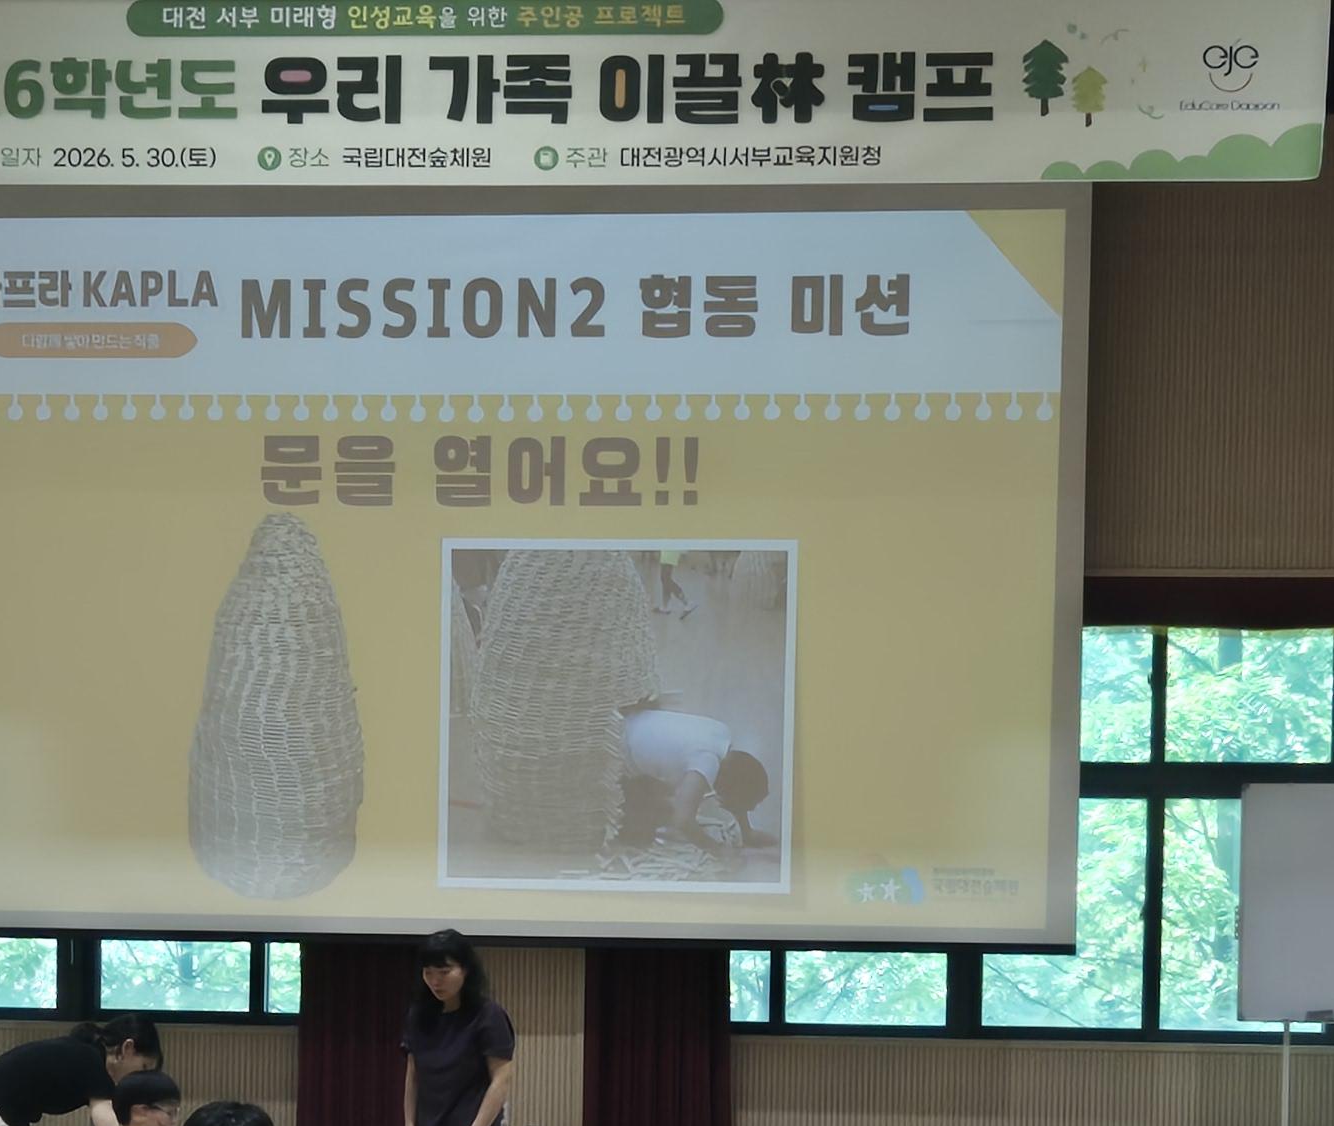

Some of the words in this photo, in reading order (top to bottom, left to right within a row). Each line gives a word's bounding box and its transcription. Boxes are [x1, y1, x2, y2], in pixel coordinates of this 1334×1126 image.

[161, 6, 207, 30] 대전
[216, 6, 260, 29] 서부
[269, 5, 337, 30] 미래형
[347, 4, 458, 29] 인성교육을
[467, 5, 508, 28] 위한
[516, 5, 584, 28] 주인공
[594, 4, 686, 27] 프로젝트
[261, 55, 403, 125] 우리
[428, 52, 573, 125] 가족
[598, 52, 825, 125] 이끌林
[846, 51, 995, 123] 캠프
[0, 146, 42, 168] 일자
[53, 146, 115, 169] 2026.
[120, 147, 140, 168] 5.
[146, 145, 218, 170] 30.(토)
[287, 146, 330, 169] 장소
[342, 146, 492, 169] 국립대전숲체원
[566, 147, 609, 169] 주관
[619, 145, 883, 169] 대전광역시서부교육지원청
[82, 269, 219, 308] KAPLA
[240, 277, 606, 339] MISSION2
[638, 273, 759, 339] 협동
[790, 273, 910, 336] 미션
[260, 434, 396, 507] 문을
[433, 434, 700, 507] 열어요!!
